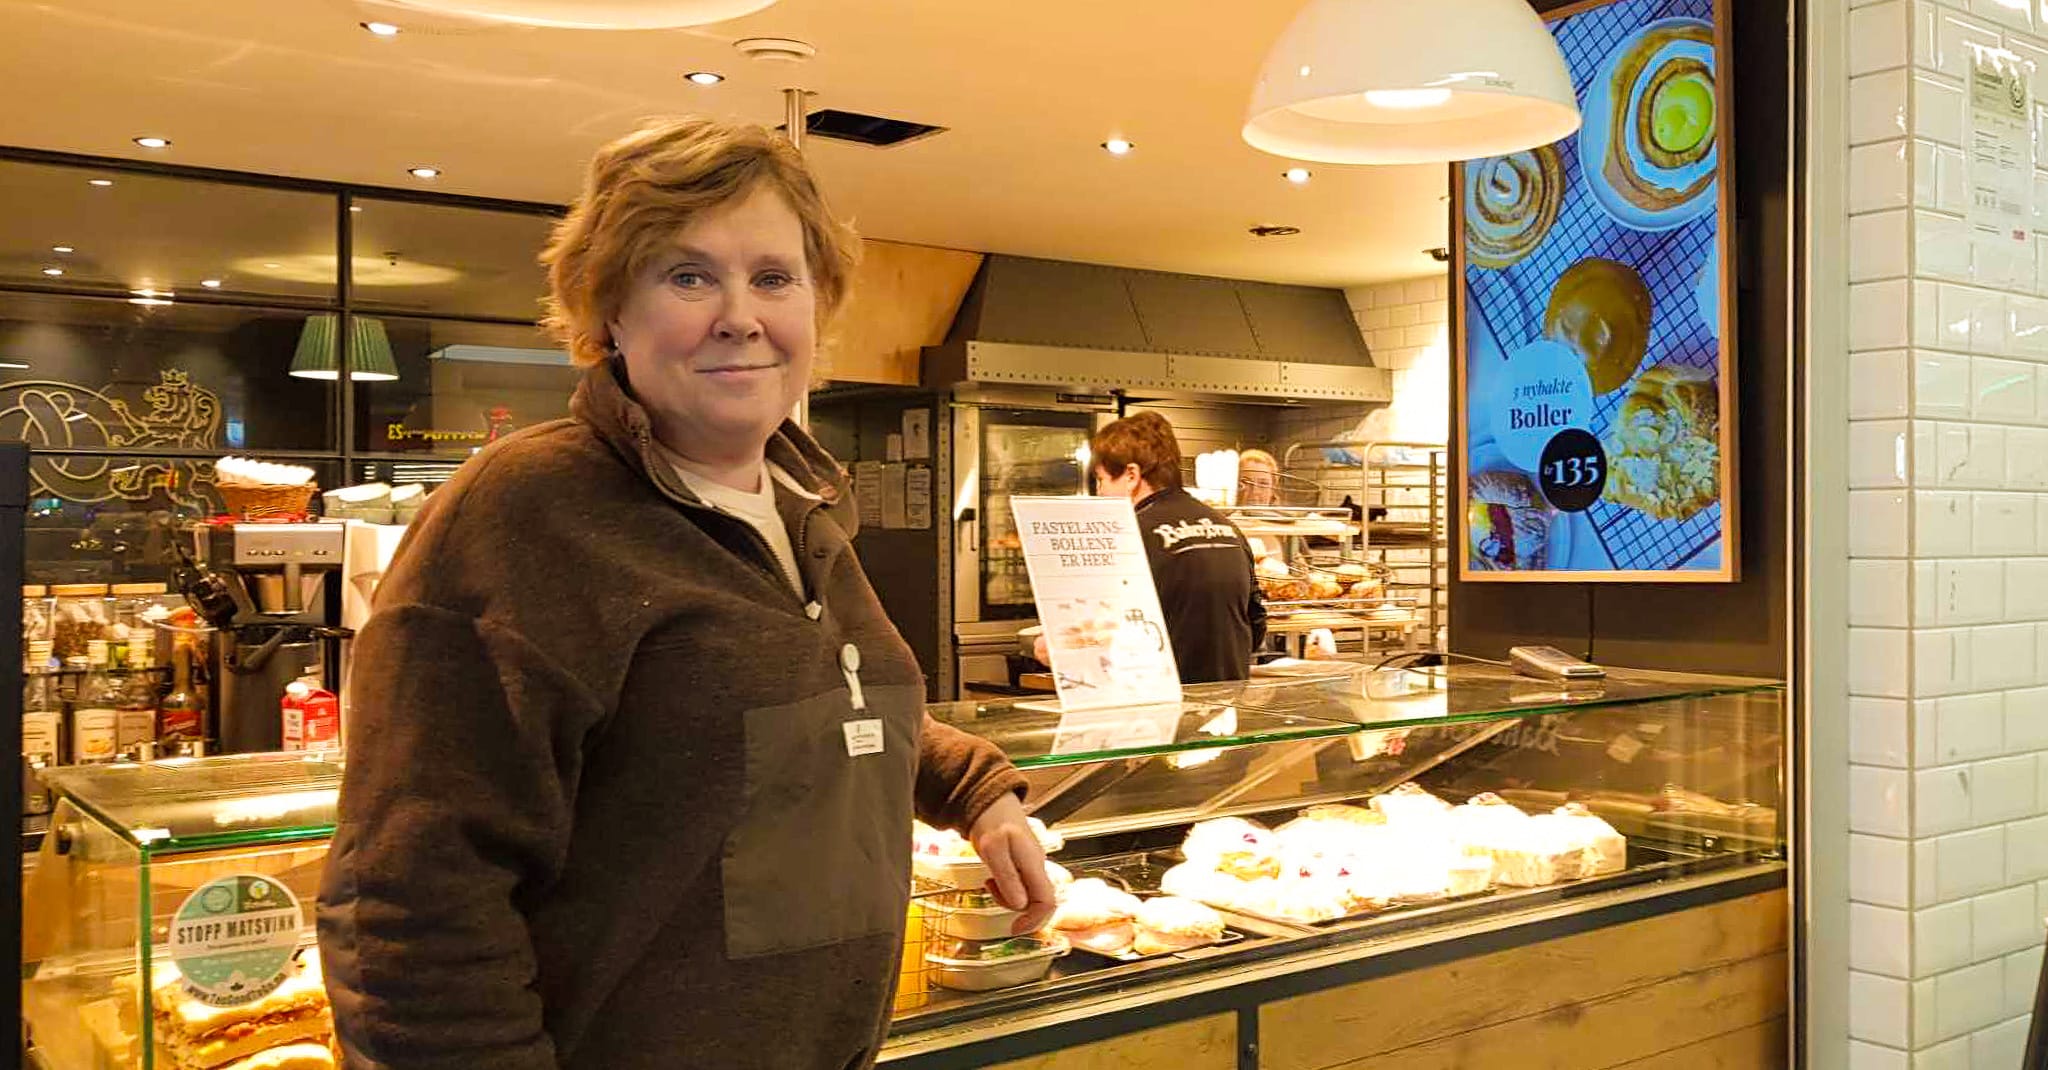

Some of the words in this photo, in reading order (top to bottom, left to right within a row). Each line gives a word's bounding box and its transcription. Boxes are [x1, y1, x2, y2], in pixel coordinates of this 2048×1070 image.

[1523, 379, 1573, 399] nybakte
[1510, 404, 1572, 430] Boller
[1050, 537, 1117, 551] BOLLENE
[1060, 553, 1081, 567] ER
[177, 922, 221, 945] STOPP
[226, 914, 296, 939] MATSVINN
